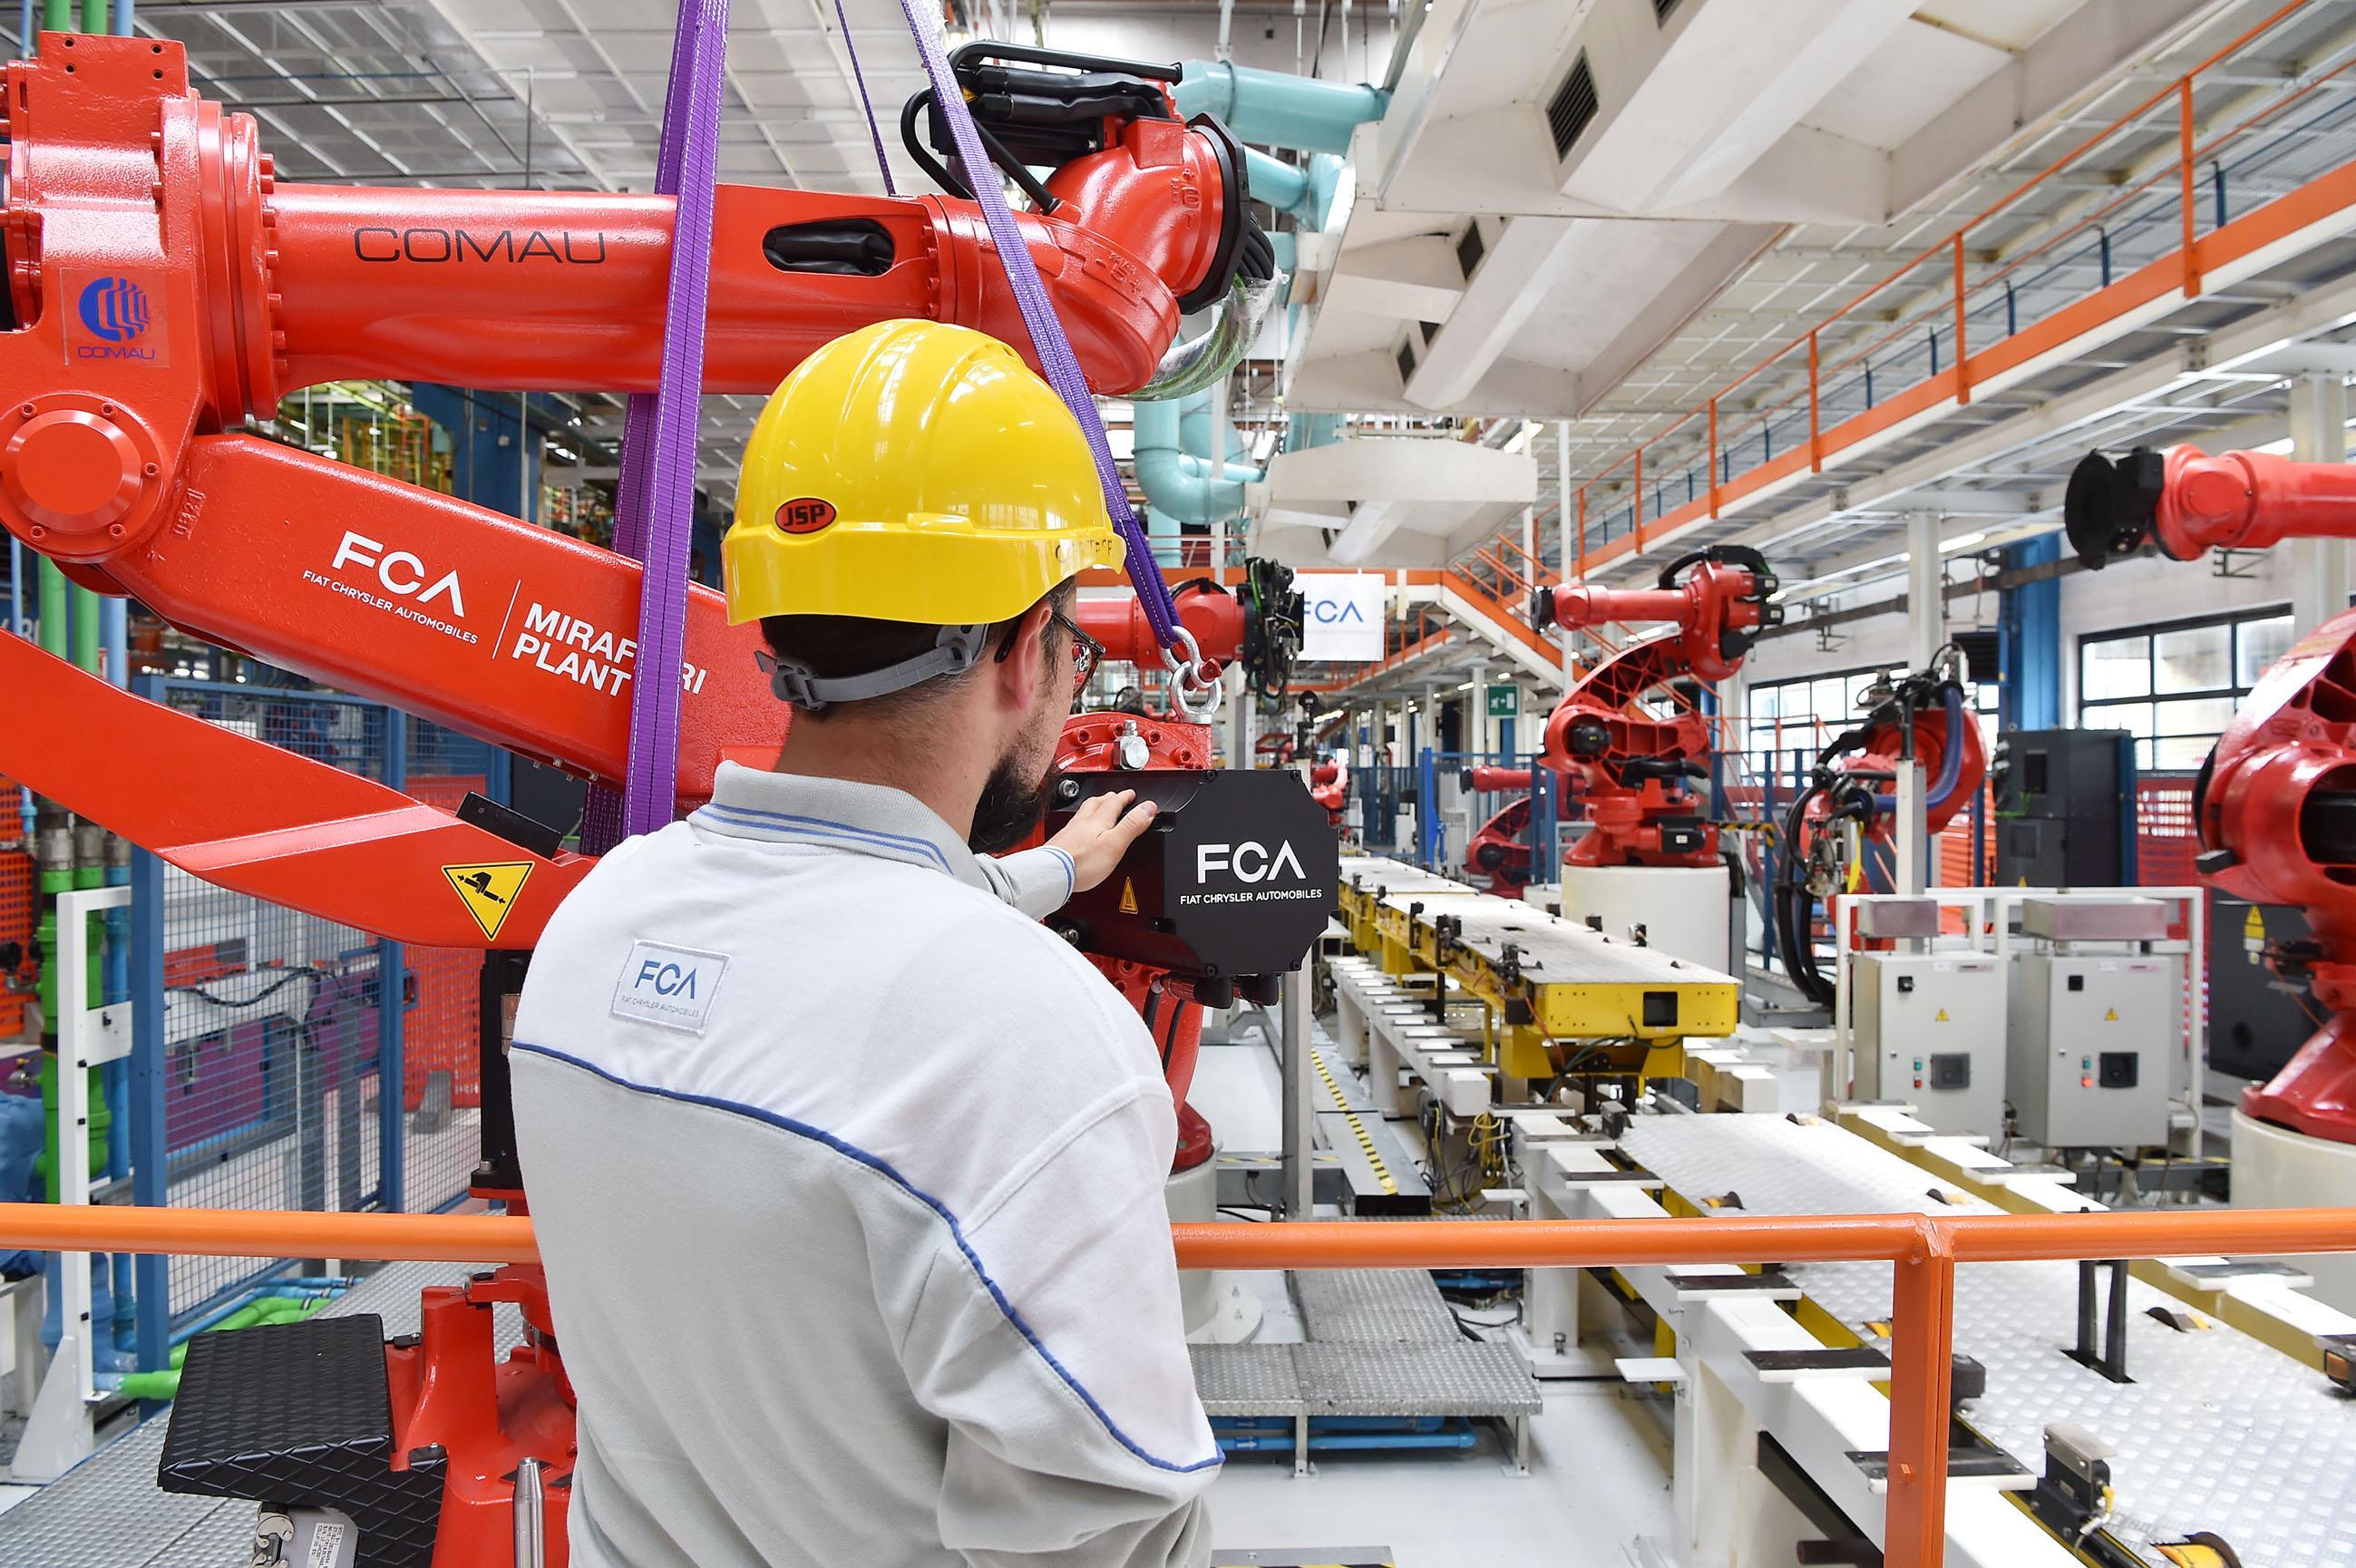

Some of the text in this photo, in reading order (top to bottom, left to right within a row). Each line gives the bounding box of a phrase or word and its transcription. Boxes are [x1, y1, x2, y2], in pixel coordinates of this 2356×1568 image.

[355, 227, 606, 264] COMAU
[78, 346, 155, 360] COMAU
[783, 503, 825, 527] JSP
[331, 530, 465, 618] FCA
[302, 570, 479, 645] FIAT CHRYSLER AUTOMOBILES
[511, 632, 632, 697] PLANT
[523, 602, 707, 696] MIRAFRI
[1197, 839, 1307, 884] FCA
[1180, 889, 1323, 905] FIAT CHRYSLER AUTOMOBILES
[634, 959, 697, 999] FCA
